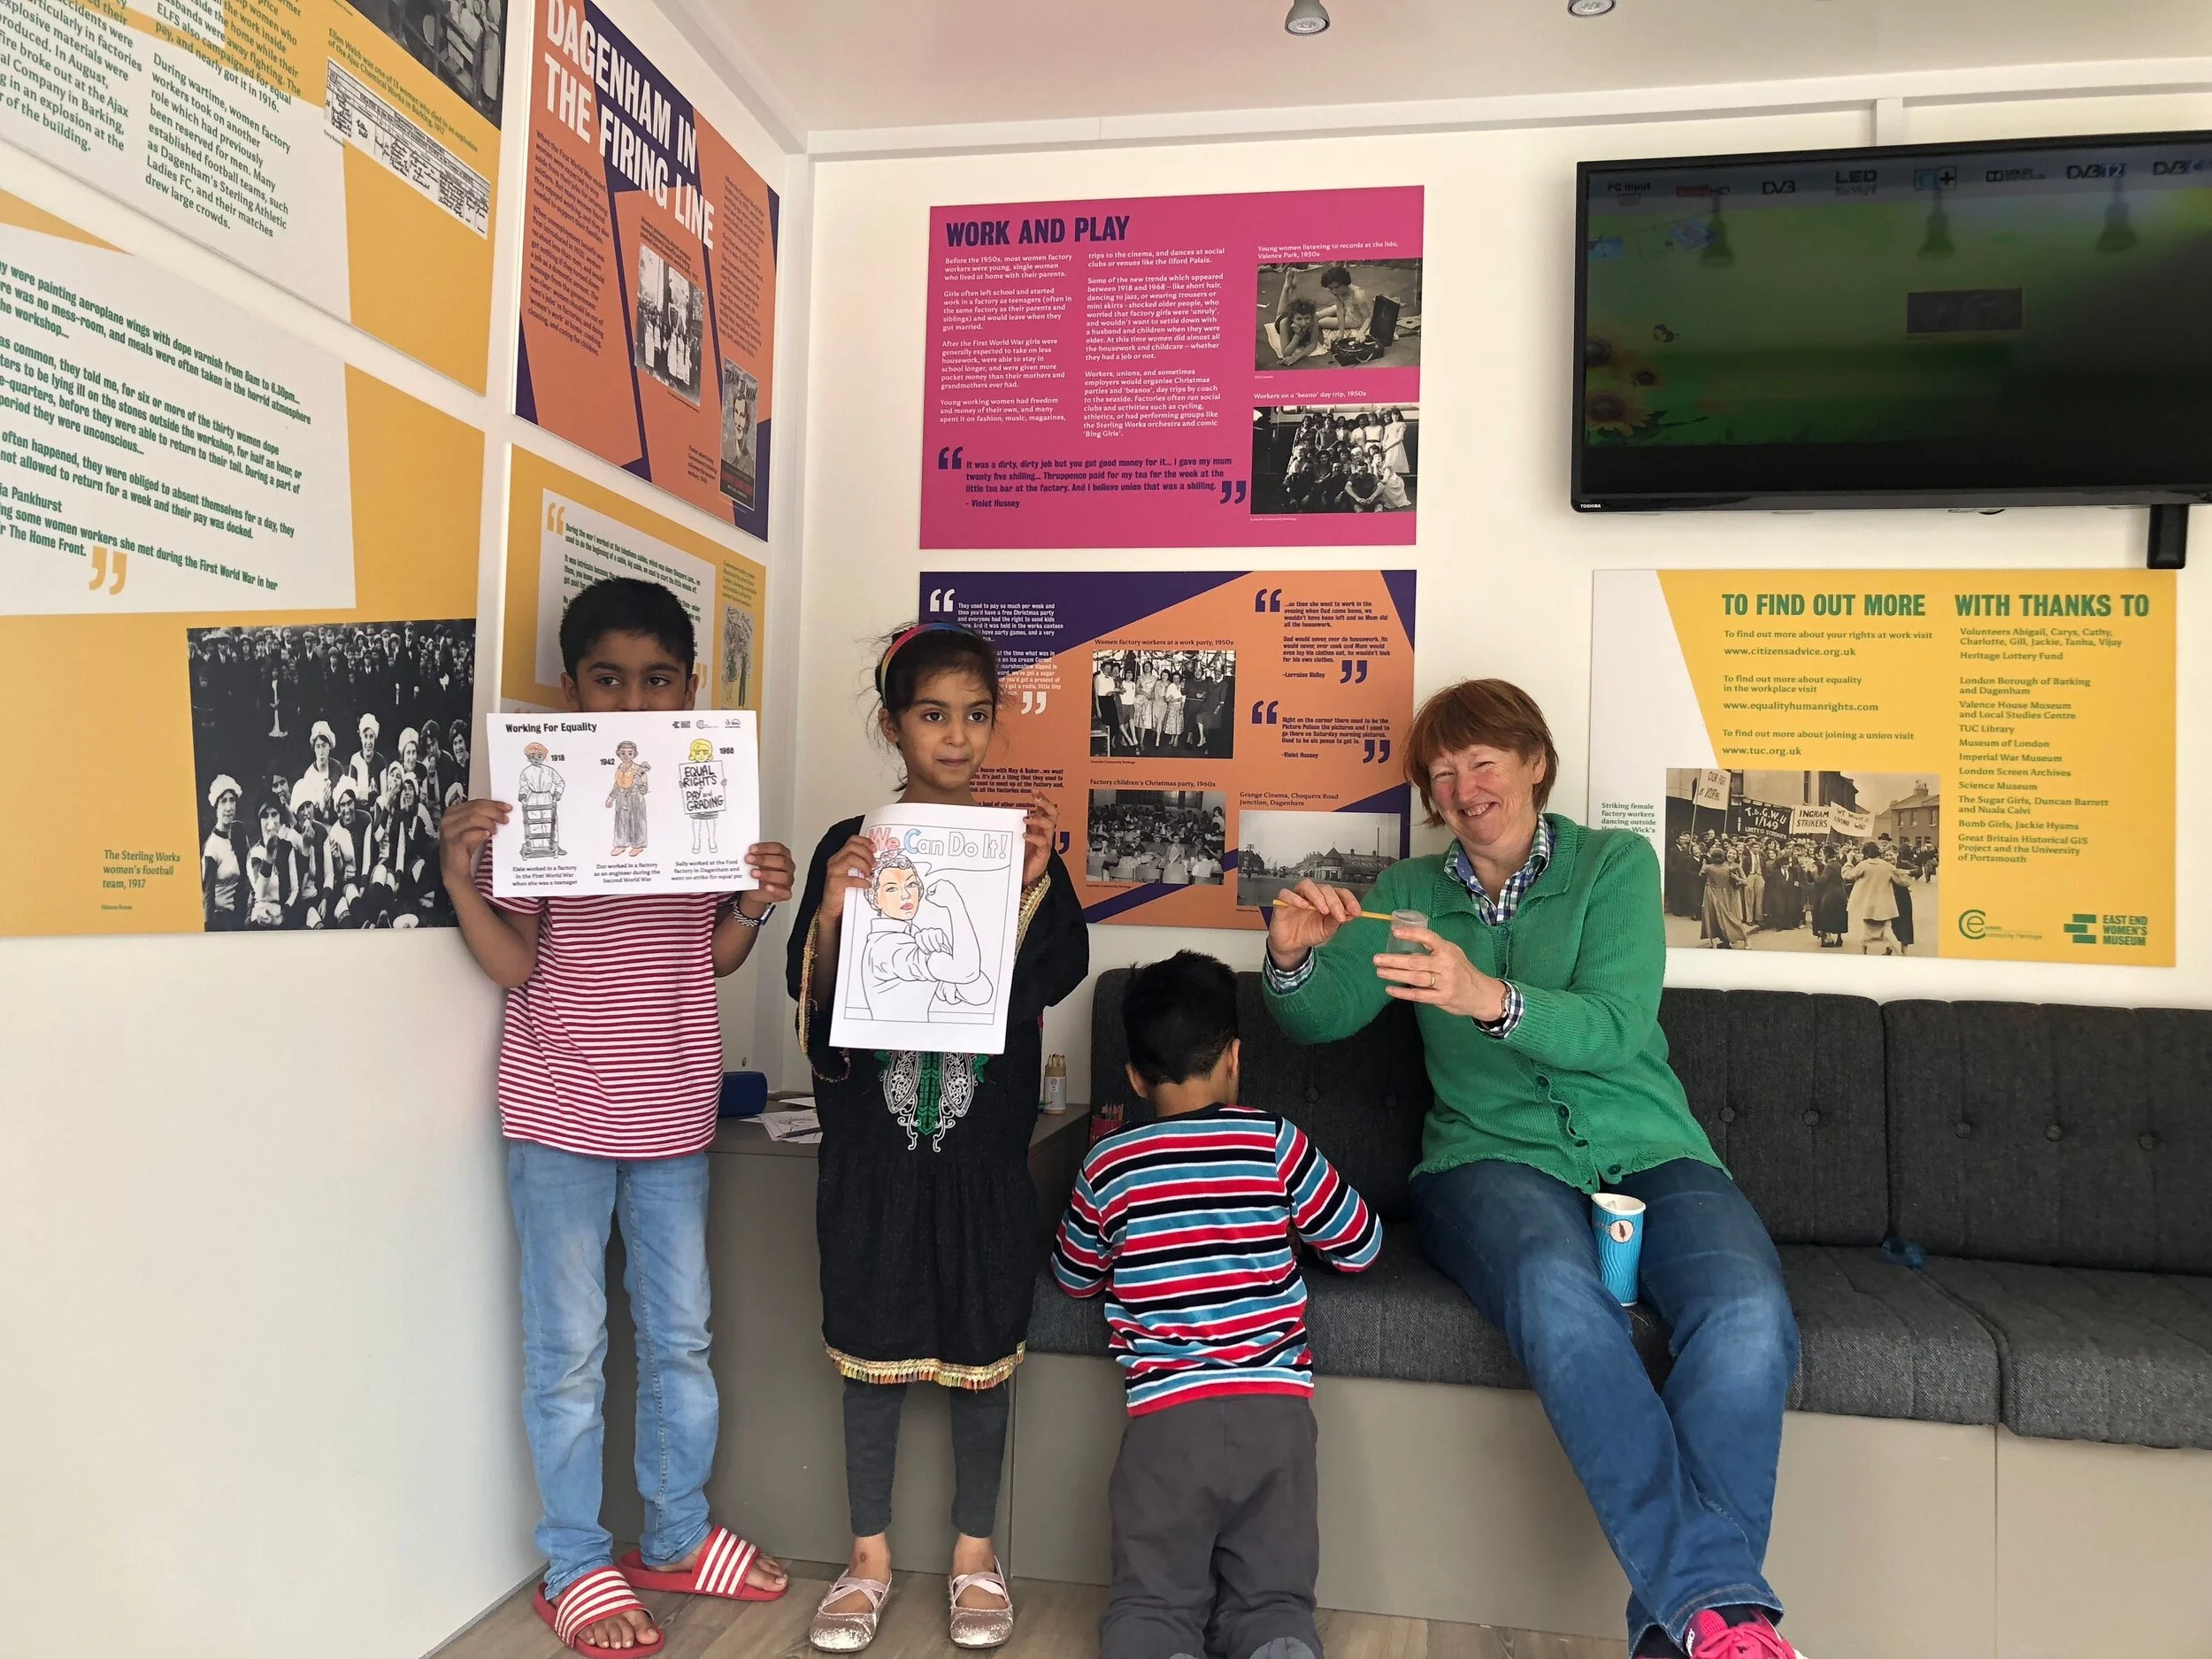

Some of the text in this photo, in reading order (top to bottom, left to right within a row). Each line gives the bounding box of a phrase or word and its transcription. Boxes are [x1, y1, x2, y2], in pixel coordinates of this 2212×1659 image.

[547, 0, 671, 150] DAGENHAM
[677, 115, 696, 175] IN
[544, 51, 592, 144] THE
[599, 104, 669, 210] FIRING
[674, 173, 714, 251] LINE
[1835, 169, 1878, 184] LED
[147, 141, 157, 152] as
[219, 181, 253, 211] Sterling
[254, 204, 286, 228] Athletic
[1607, 182, 1622, 192] PC
[145, 174, 230, 228] drew large crowds.
[147, 157, 273, 236] Ladies FC, and their matches
[946, 216, 1130, 247] WORK AND PLAY
[14, 308, 69, 337] workshop...
[11, 267, 299, 403] were painting aeroplane wings with dope varnish from 8am to 6.30pm...
[10, 488, 62, 511] Pankhurst
[994, 500, 1020, 509] Hussey
[9, 525, 86, 556] The Home Front.
[1722, 594, 1926, 616] TO FIND OUT MORE
[1955, 594, 2149, 617] WITH THANKS TO
[1848, 631, 1876, 640] rights
[2012, 628, 2048, 637] Abigail,
[2050, 628, 2080, 638] Carys,
[2082, 628, 2113, 638] Cathy,
[1724, 648, 1855, 657] www.citizensadvice.org.uk
[1997, 677, 2039, 687] Borough
[2053, 678, 2091, 687] Barking
[1979, 687, 2031, 695] Dagenham
[1723, 703, 1878, 712] www.equalityhumanrights.com
[505, 722, 597, 734] Working For Equality
[1981, 725, 2015, 734] Library
[1722, 748, 1801, 757] www.tuc.org.uk
[685, 765, 715, 777] EQUAL
[683, 775, 717, 787] RIGHTS
[687, 790, 701, 800] PAY
[687, 795, 724, 811] GRADING
[1601, 803, 1630, 811] Striking
[1601, 818, 1629, 827] dancing
[870, 828, 1009, 859] We Can Do It!
[104, 849, 180, 864] The Sterling Works
[103, 864, 174, 876] women's football
[103, 879, 146, 889] team, 1917
[2102, 915, 2147, 926] EAST END
[2102, 935, 2146, 946] MUSEUM
